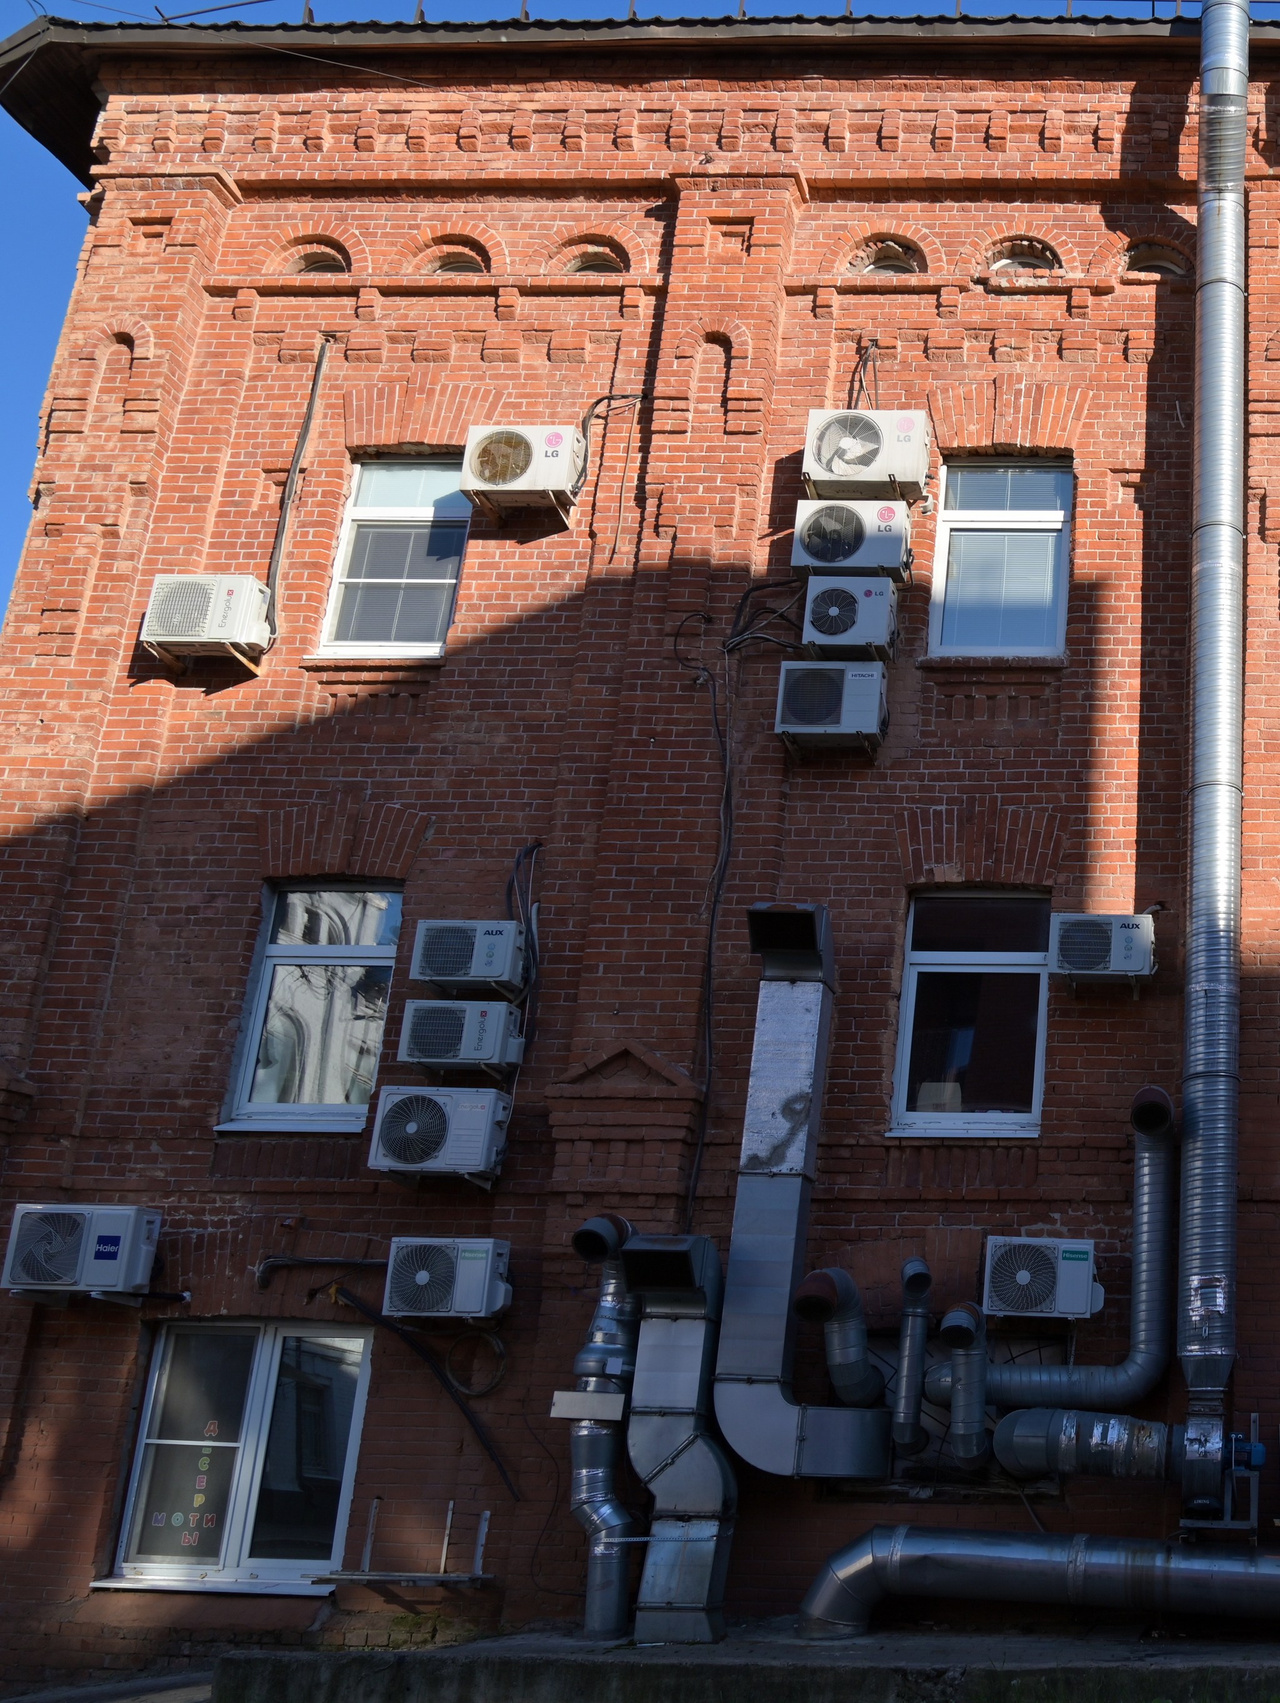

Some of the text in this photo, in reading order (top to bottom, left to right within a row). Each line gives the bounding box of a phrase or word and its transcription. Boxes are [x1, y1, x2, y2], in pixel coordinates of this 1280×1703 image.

[896, 434, 911, 443] LG
[544, 450, 559, 458] LG
[877, 524, 893, 533] LG
[473, 1010, 488, 1052] Energolux
[95, 1244, 119, 1252] Haier
[151, 1512, 217, 1528] МОТИ
